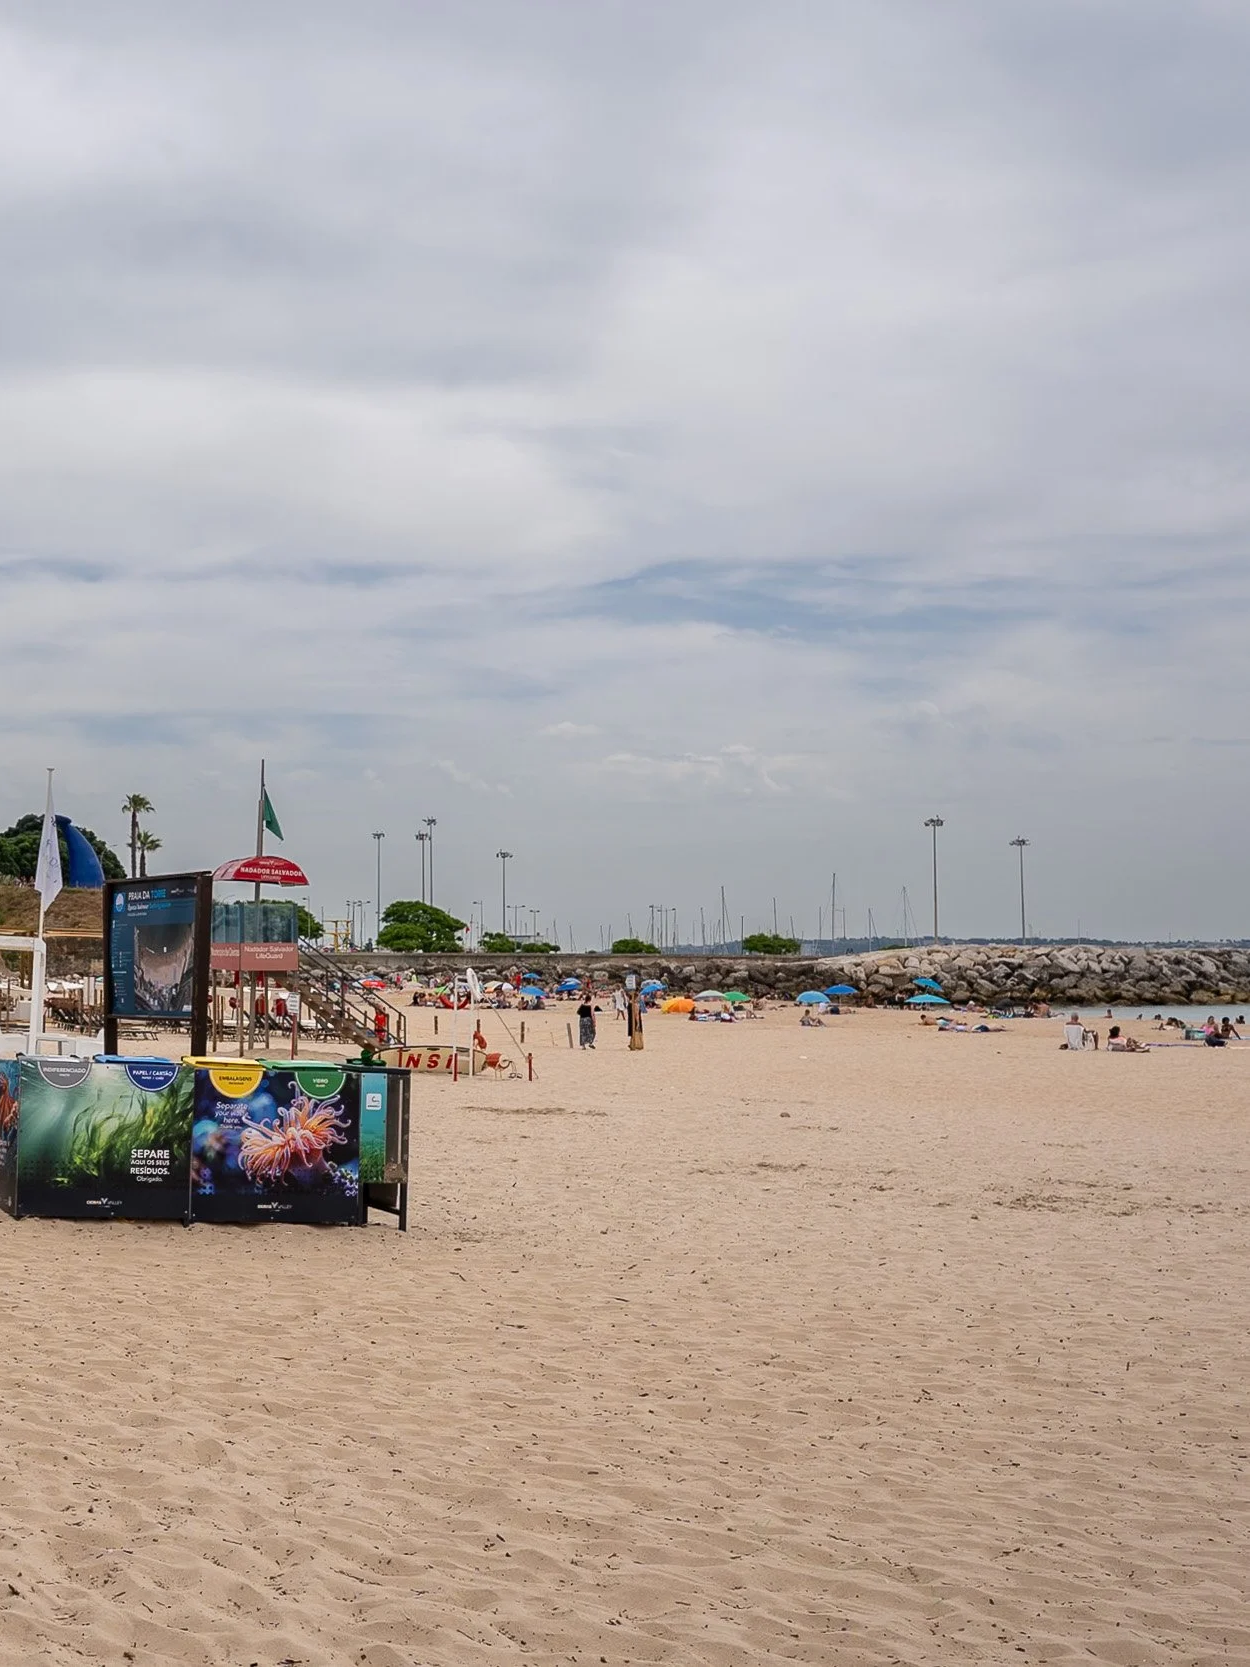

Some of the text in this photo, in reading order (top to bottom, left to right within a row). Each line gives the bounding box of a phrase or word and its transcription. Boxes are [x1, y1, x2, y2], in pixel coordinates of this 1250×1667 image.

[271, 867, 302, 877] SALVADOR
[128, 890, 142, 901] PRAIA
[142, 890, 150, 900] DA
[216, 1101, 249, 1111] Separate
[131, 1149, 170, 1159] SEPARE
[130, 1166, 170, 1175] RESÍDUOS.
